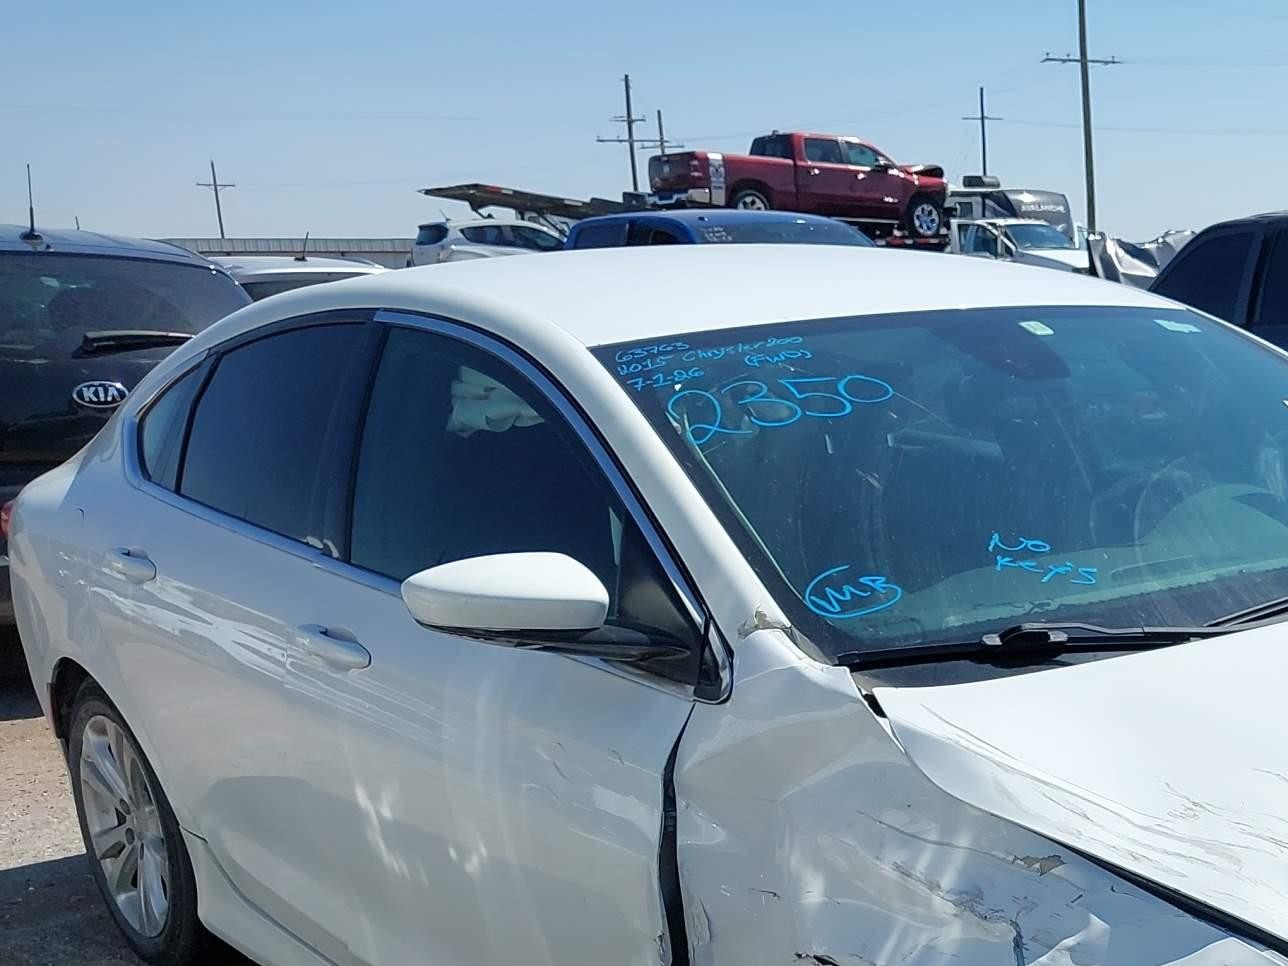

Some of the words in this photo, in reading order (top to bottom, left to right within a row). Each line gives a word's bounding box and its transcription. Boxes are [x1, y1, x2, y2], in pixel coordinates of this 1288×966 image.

[617, 354, 673, 376] 2015
[766, 336, 803, 348] 200
[82, 387, 122, 402] KIA
[667, 375, 895, 445] 2350
